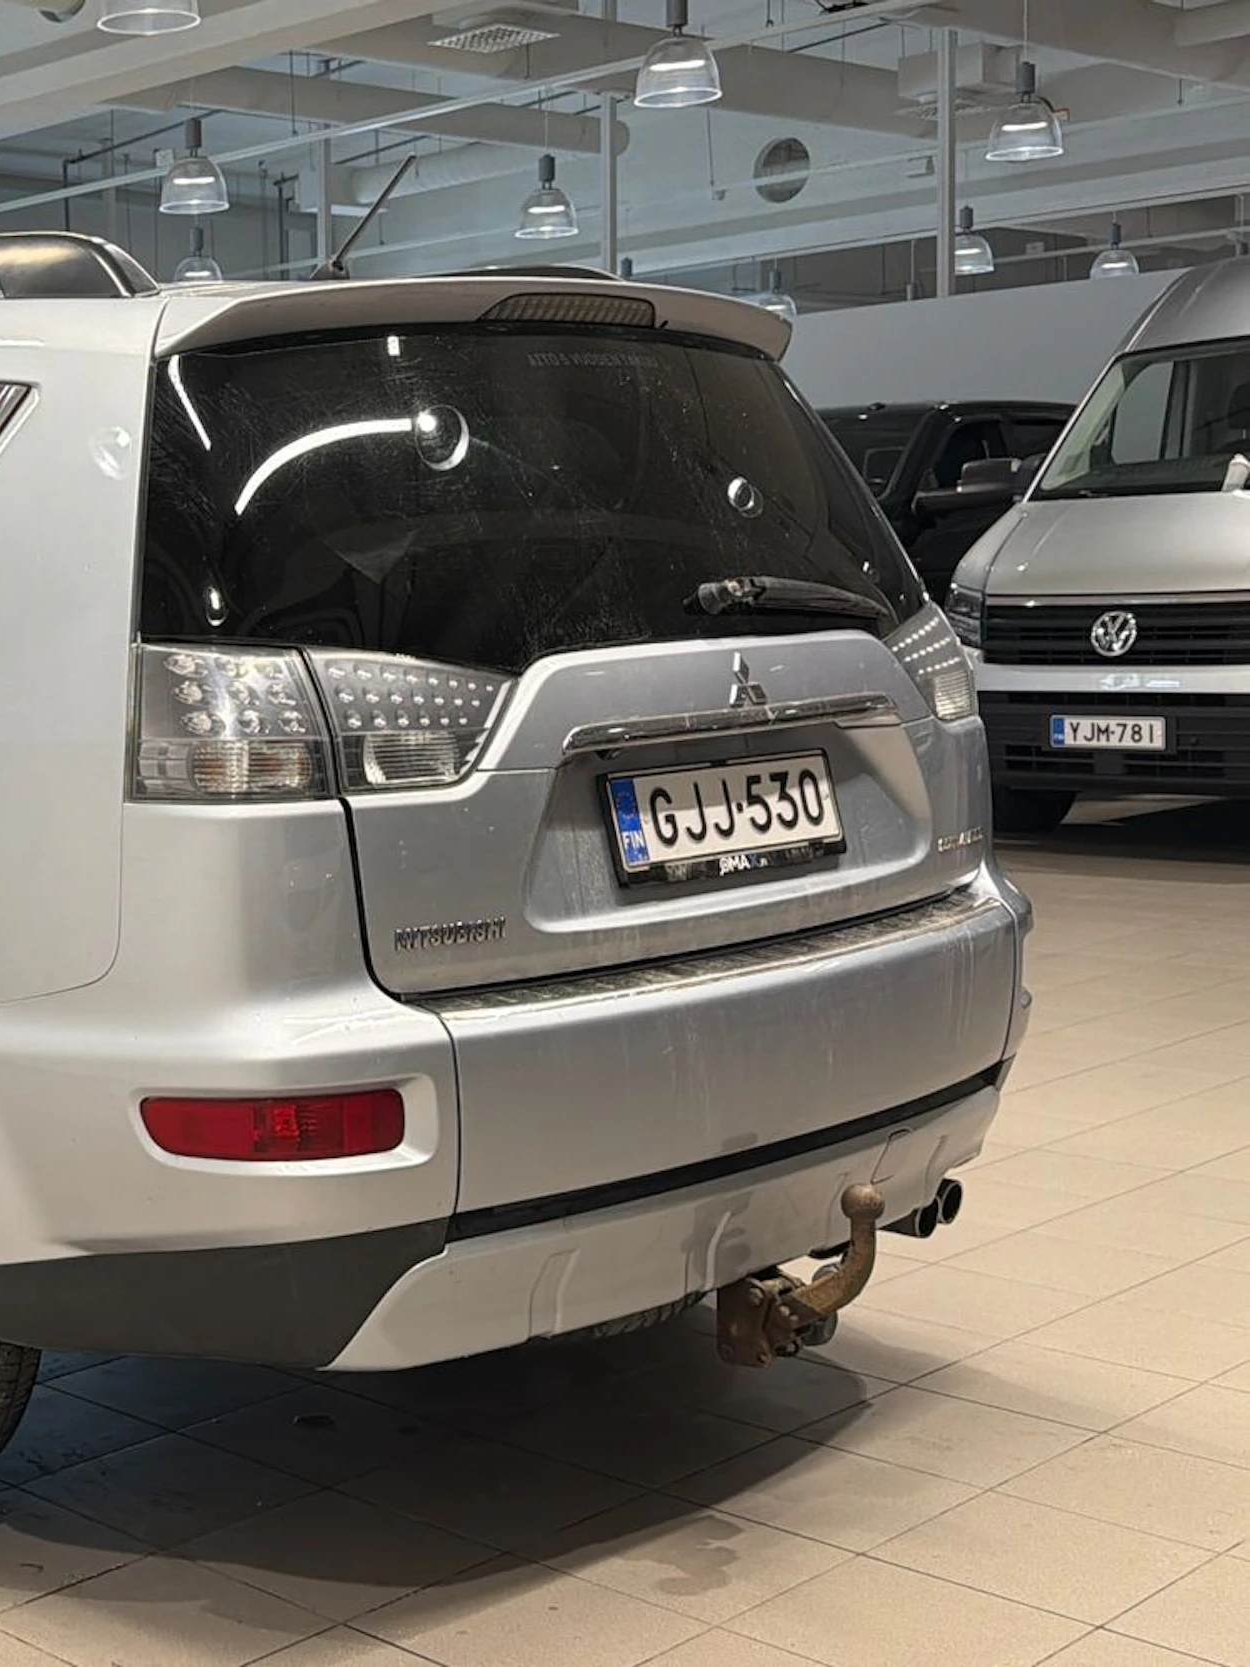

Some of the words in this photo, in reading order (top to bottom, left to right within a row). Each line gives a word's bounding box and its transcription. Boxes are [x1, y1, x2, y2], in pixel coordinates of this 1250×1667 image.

[1069, 721, 1154, 743] YJM-781
[649, 768, 824, 847] GJJ-530
[621, 830, 646, 850] FIN
[394, 916, 506, 951] MITSUBISHI
